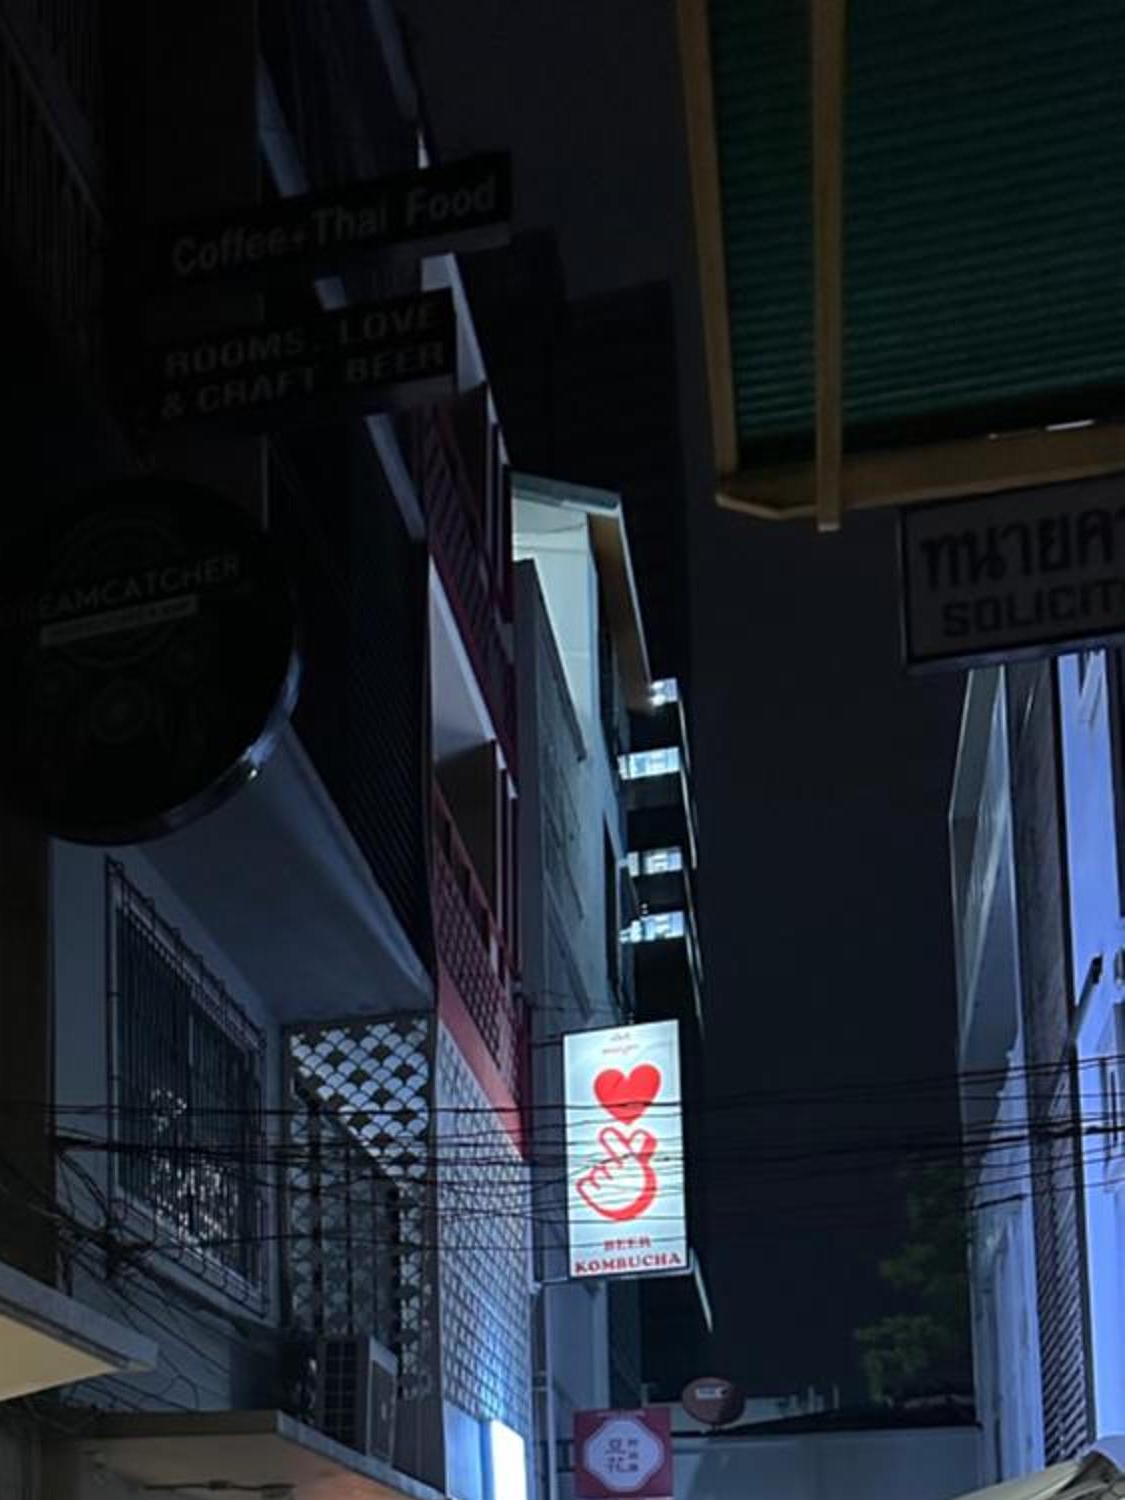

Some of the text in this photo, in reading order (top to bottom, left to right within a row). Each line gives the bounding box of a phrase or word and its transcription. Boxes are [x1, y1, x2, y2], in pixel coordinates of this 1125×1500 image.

[405, 175, 497, 227] Food
[339, 301, 441, 345] LOVE
[196, 366, 317, 413] CRAFT
[345, 341, 444, 384] BEER
[921, 506, 1125, 590] ทนายค
[942, 576, 1125, 638] SOLICIT
[575, 1252, 681, 1273] KOMBUCHA
